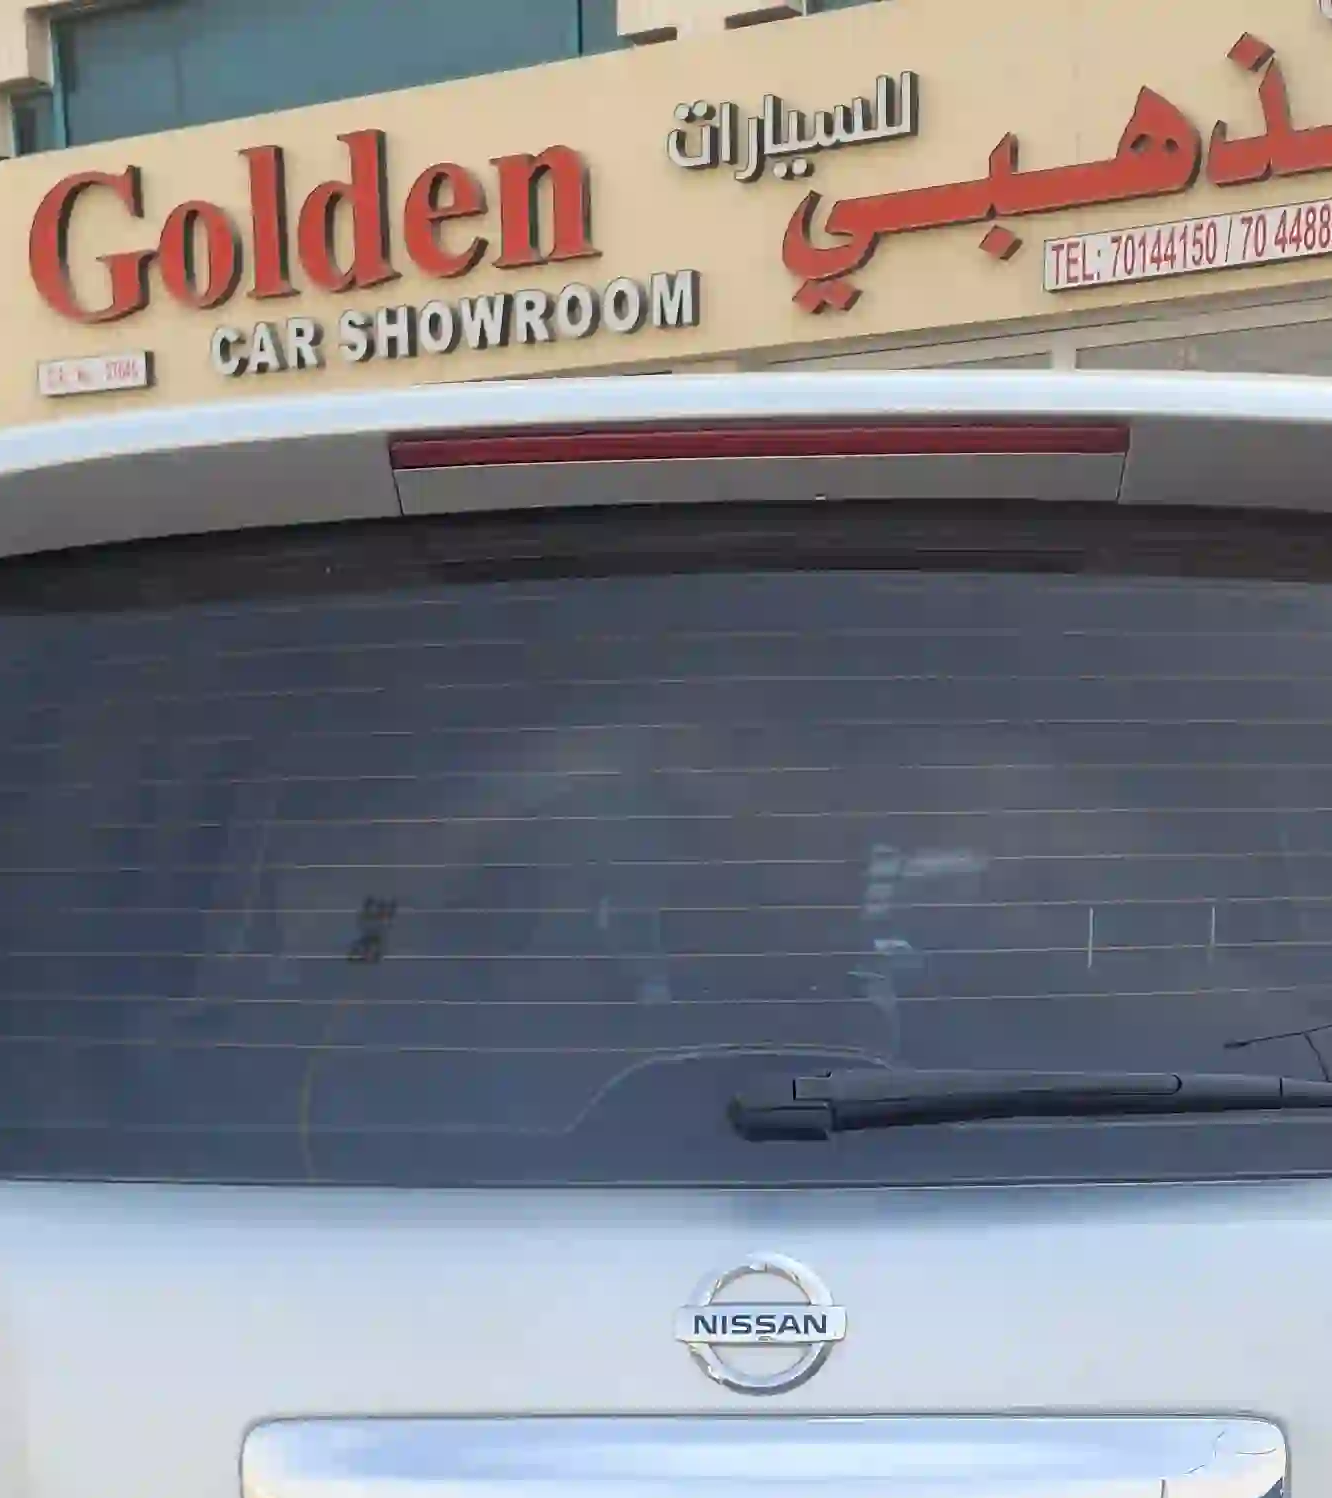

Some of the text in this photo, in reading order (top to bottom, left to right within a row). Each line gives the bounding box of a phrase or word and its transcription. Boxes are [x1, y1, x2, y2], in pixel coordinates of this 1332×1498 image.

[666, 71, 919, 183] للسيارات
[29, 128, 601, 325] Golden
[1051, 238, 1101, 285] TEL:
[1109, 220, 1218, 278] 70144150
[1239, 214, 1268, 261] 70
[209, 269, 700, 377] CAR SHOWROOM
[692, 1313, 827, 1335] NISSAN
